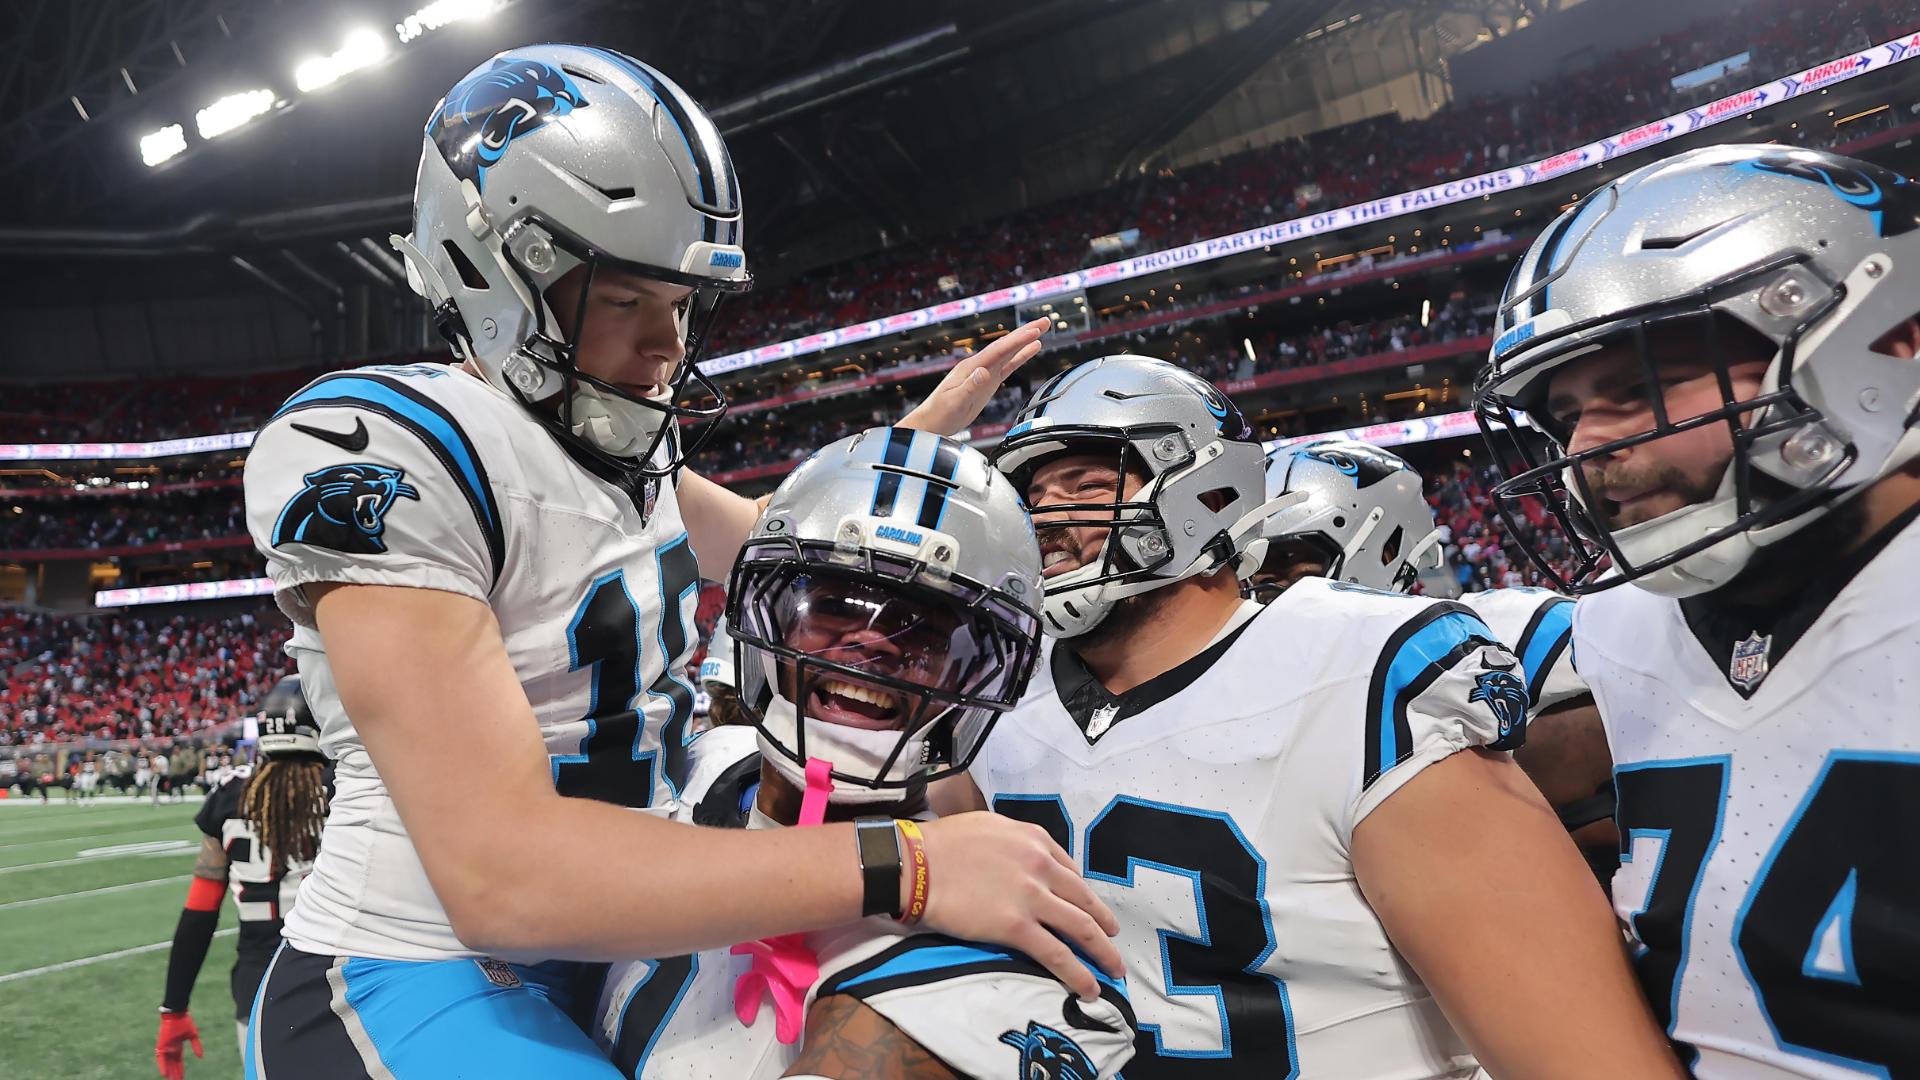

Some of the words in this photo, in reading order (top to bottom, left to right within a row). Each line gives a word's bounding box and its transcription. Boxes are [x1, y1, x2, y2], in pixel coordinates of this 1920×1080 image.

[1802, 55, 1858, 85] ARROW
[1706, 91, 1757, 118] ARROW
[1132, 246, 1199, 273] PROUD
[1206, 220, 1303, 256] PARTNER
[1311, 214, 1338, 230] OF
[1349, 199, 1393, 221] THE
[1401, 172, 1513, 209] FALCONS
[875, 525, 923, 546] CAROLINA
[266, 717, 285, 734] 28
[915, 865, 926, 900] Noles!
[1613, 749, 1920, 1080] 74
